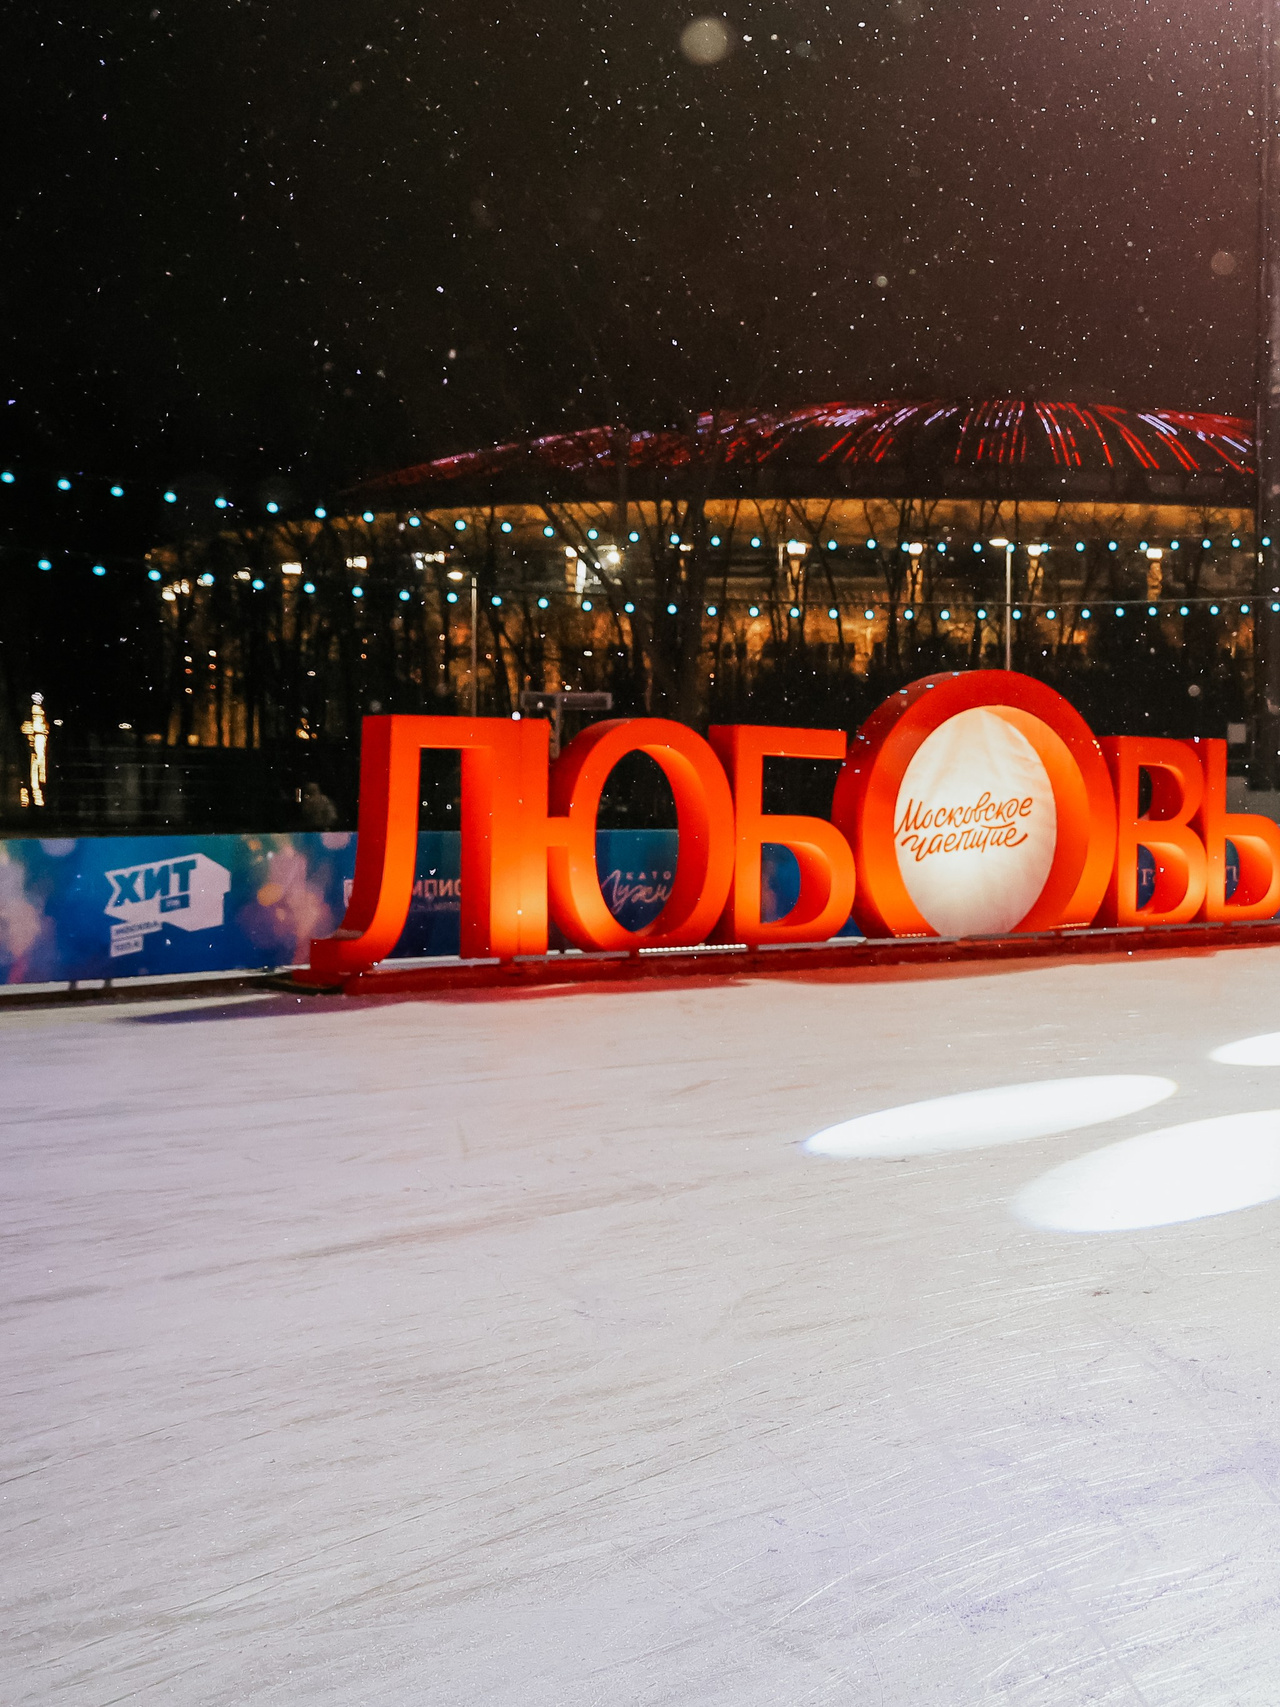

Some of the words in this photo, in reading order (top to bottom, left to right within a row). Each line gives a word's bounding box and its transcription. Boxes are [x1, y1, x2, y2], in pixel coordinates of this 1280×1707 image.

[894, 791, 1033, 840] Московское
[113, 859, 197, 908] ХИТ
[625, 871, 672, 880] КАТО
